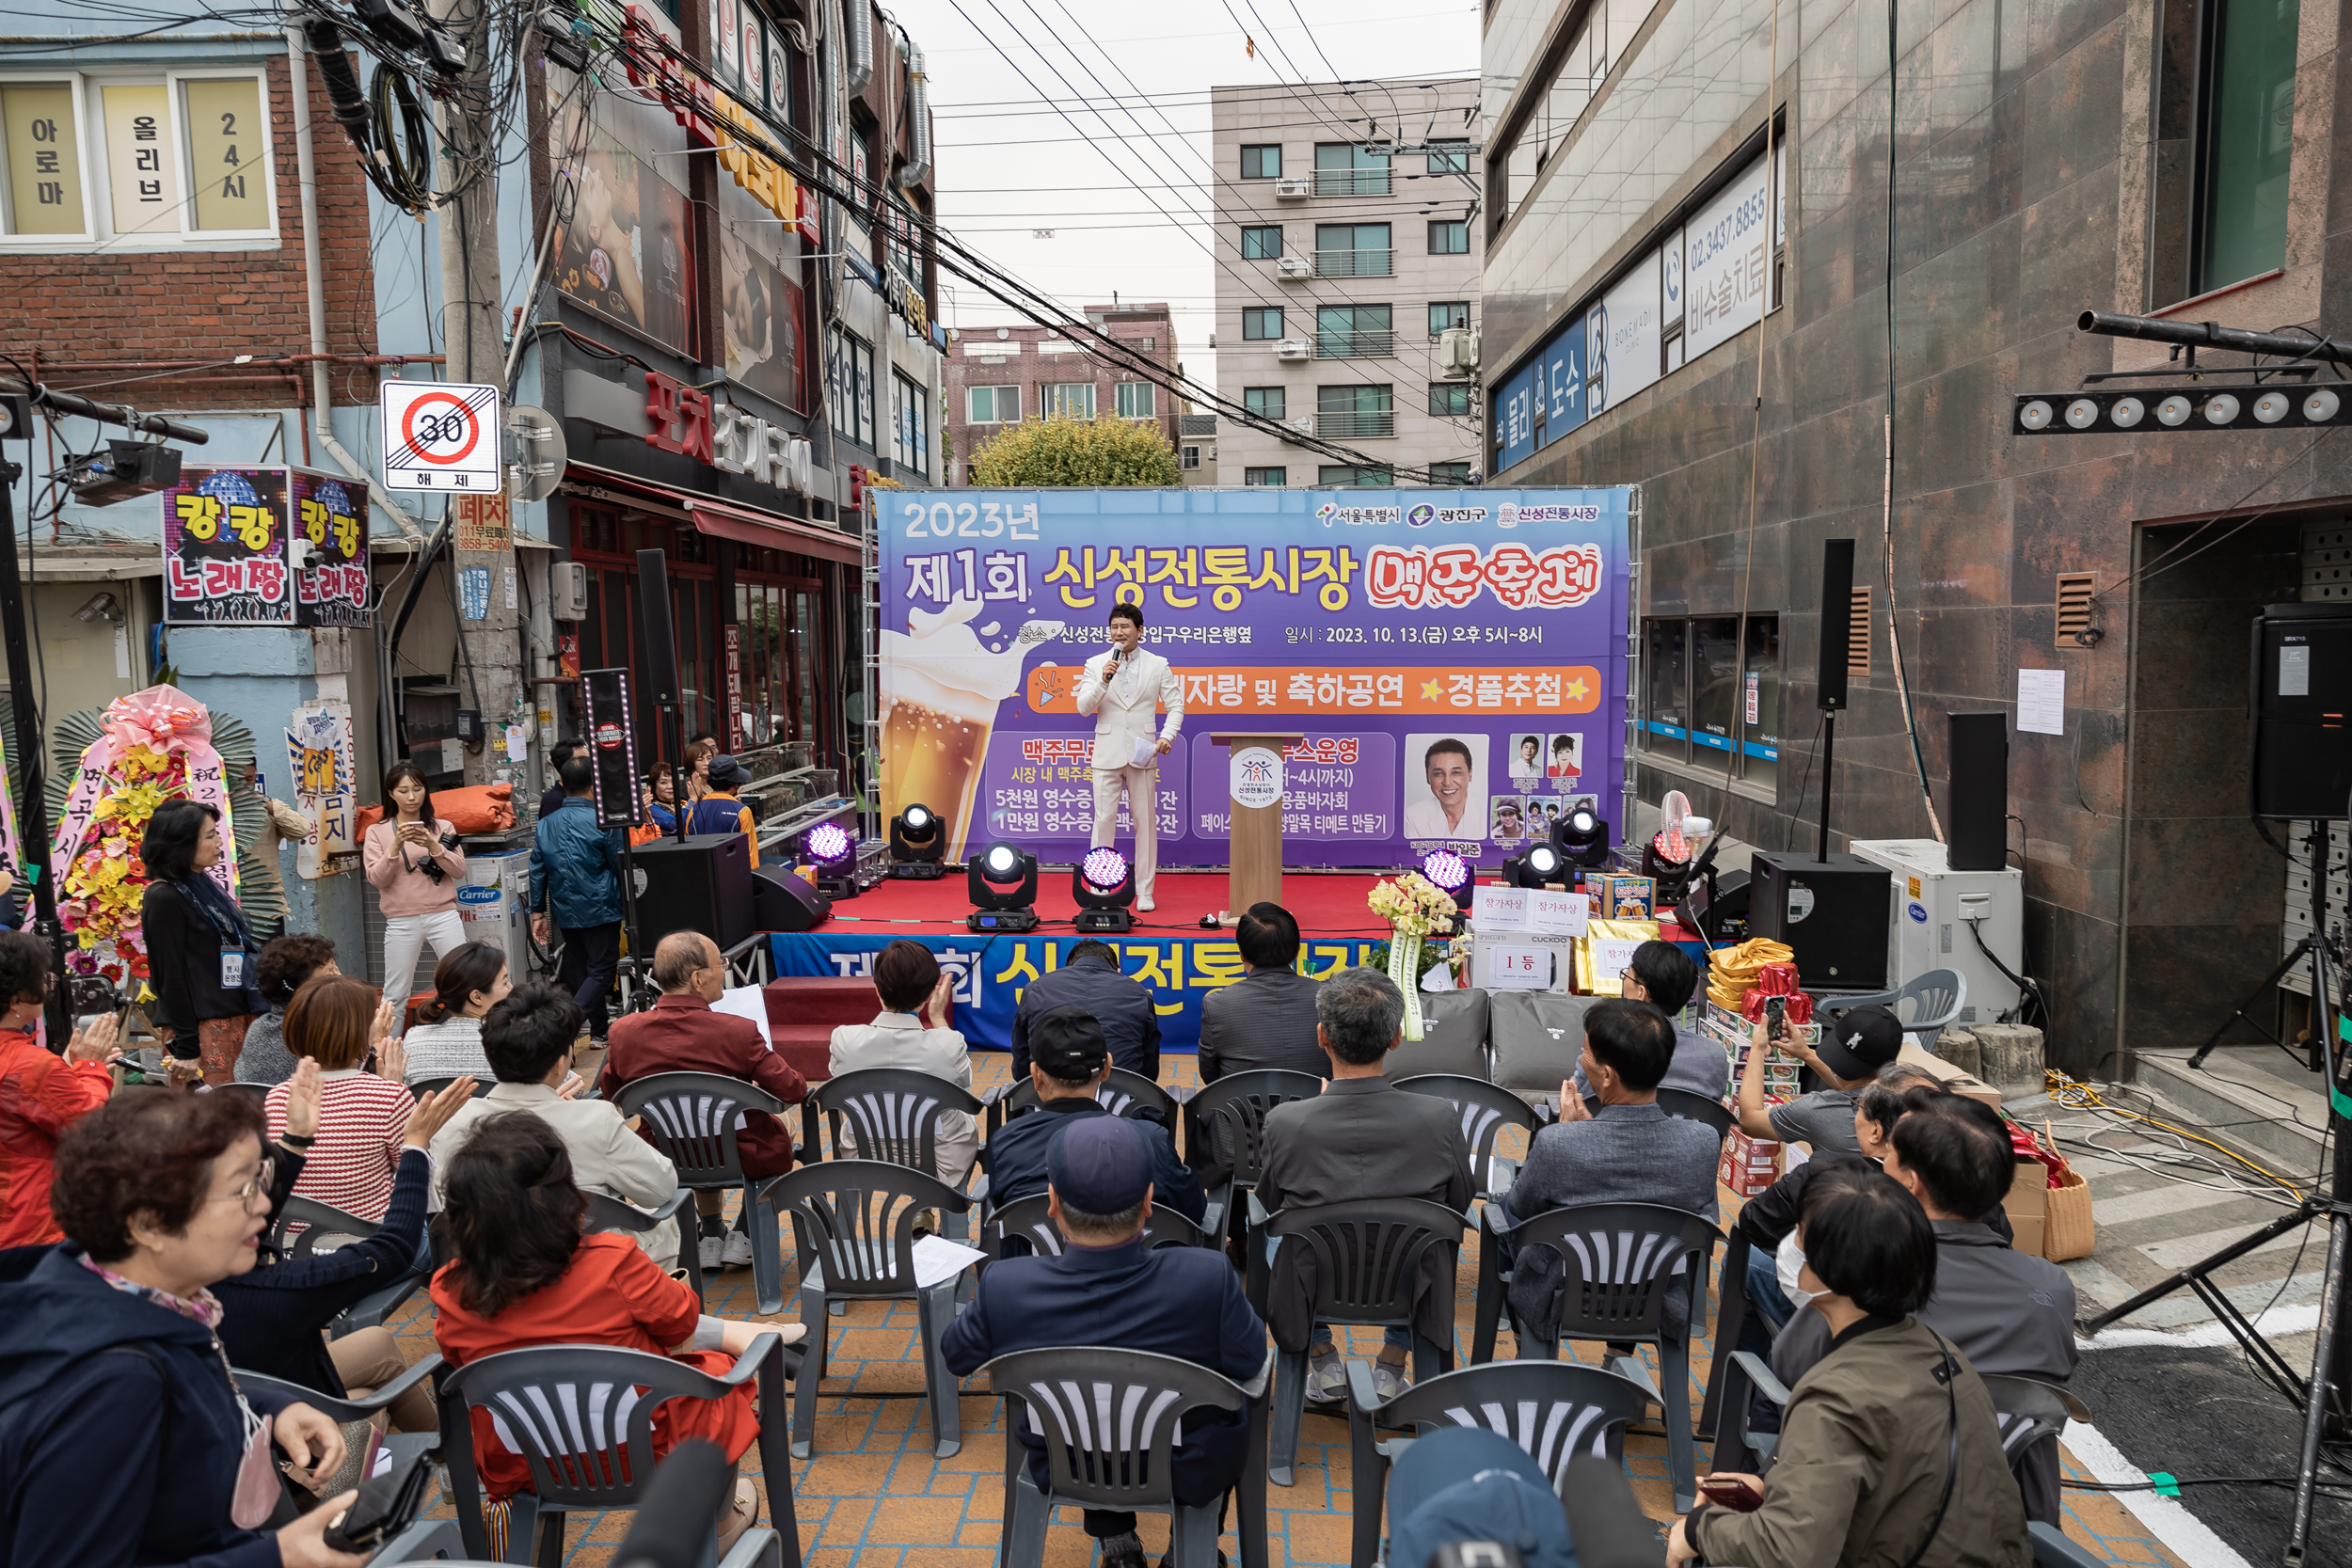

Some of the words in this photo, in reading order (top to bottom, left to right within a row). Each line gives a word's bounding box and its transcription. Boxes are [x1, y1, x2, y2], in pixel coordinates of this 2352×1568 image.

[31, 118, 64, 205] 아로마
[133, 116, 163, 202] 올리브
[221, 112, 246, 198] 24시
[1691, 186, 1766, 273] 02.3437.8855
[1690, 241, 1765, 336] 비수술치료
[1614, 308, 1652, 348] BONEMADI
[1508, 386, 1530, 449] 물리
[1551, 349, 1580, 420] 도수
[421, 414, 462, 443] 30
[645, 372, 716, 467] 포차
[714, 404, 815, 499] 조개구이
[417, 473, 432, 485] 해
[454, 474, 469, 486] 제
[176, 494, 275, 551] 캉캉
[904, 501, 1041, 541] 2023년
[1337, 506, 1402, 524] 서울특별시
[1438, 507, 1487, 522] 광진구
[1517, 505, 1598, 522] 신성전통시장
[300, 499, 360, 559] 캉캉
[459, 525, 476, 537] 011
[169, 557, 287, 603] 노래짱
[297, 564, 367, 608] 노래짱
[904, 547, 1028, 603] 제1회
[1043, 546, 1359, 612] 신성전통시장
[1367, 543, 1601, 610] 맥주축제
[1059, 625, 1253, 644] 신성전통장입구우리은행옆
[1284, 626, 1314, 644] 일시
[1326, 626, 1368, 644] 2023.
[1373, 626, 1395, 644] 10.
[1399, 625, 1448, 645] 13.(금)
[1451, 625, 1482, 644] 오후
[1485, 625, 1544, 644] 5시~8시
[1254, 679, 1278, 706] 및
[1286, 673, 1405, 707] 축하공연
[1447, 673, 1562, 707] 경품추첨
[192, 768, 222, 783] 祝
[1011, 767, 1037, 784] 시장
[1041, 767, 1053, 783] 내
[995, 788, 1040, 810] 5천원
[1042, 788, 1093, 810] 영수증
[997, 812, 1040, 832] 1만원
[1043, 812, 1094, 832] 영수증
[1351, 813, 1388, 834] 만들기
[459, 890, 497, 900] Carrier
[1485, 896, 1523, 911] 참가자상
[1537, 900, 1578, 915] 참가자상
[1506, 955, 1513, 969] 1
[1521, 955, 1535, 971] 등
